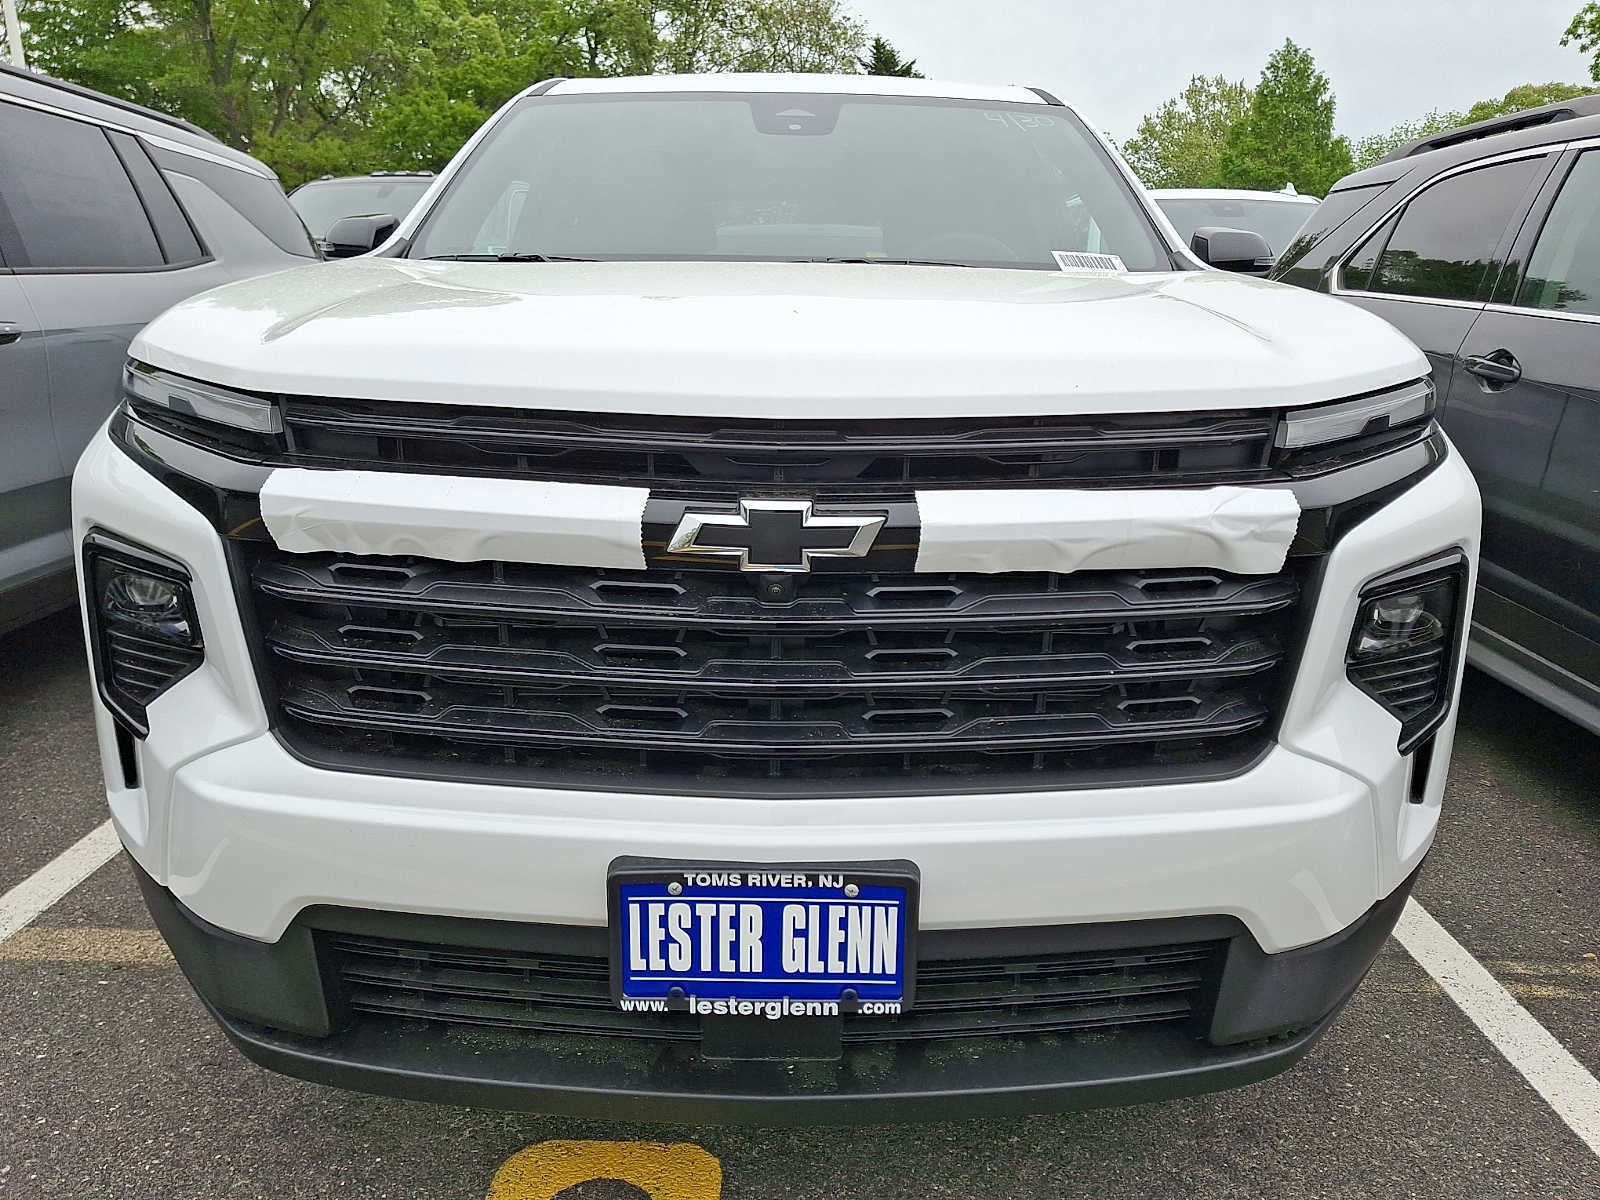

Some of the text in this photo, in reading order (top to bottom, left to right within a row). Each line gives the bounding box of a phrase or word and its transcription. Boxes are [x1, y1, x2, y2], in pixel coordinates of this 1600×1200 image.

[683, 872, 845, 889] TOMS RIVER, NJ
[628, 902, 898, 975] LESTER GLENN
[689, 997, 839, 1020] lesterglenn
